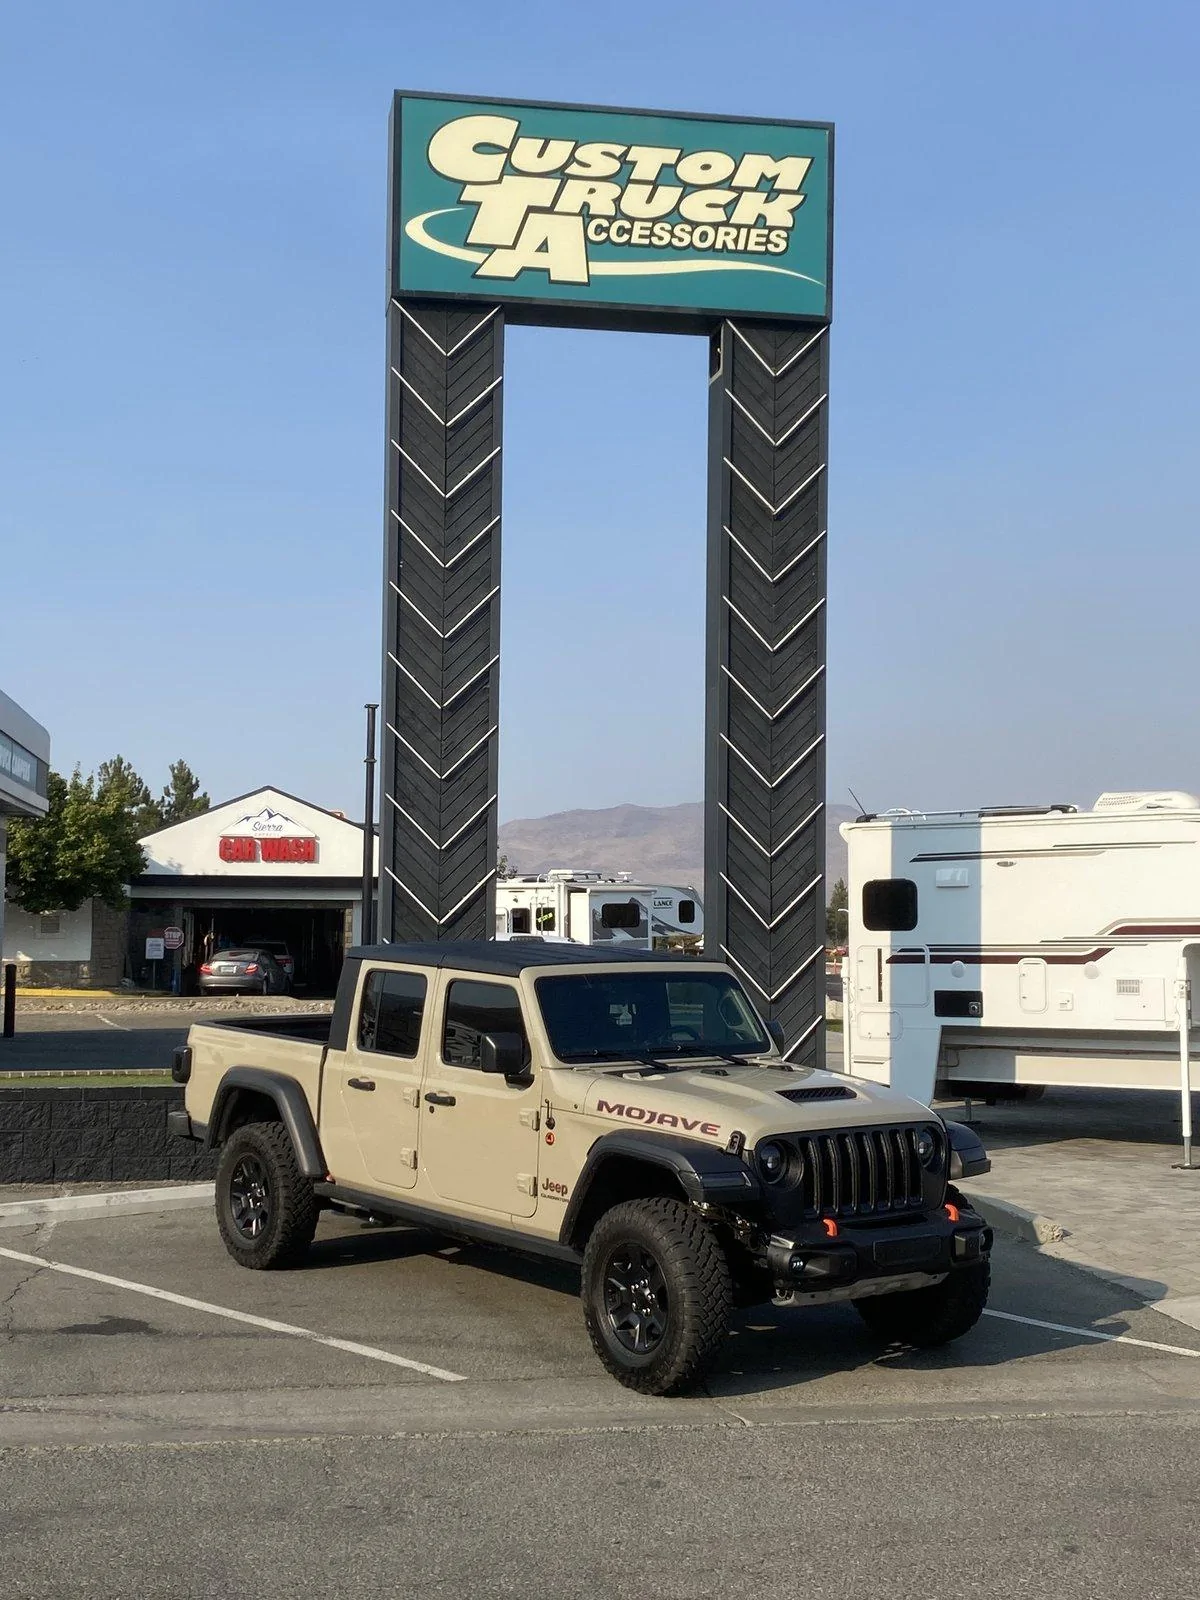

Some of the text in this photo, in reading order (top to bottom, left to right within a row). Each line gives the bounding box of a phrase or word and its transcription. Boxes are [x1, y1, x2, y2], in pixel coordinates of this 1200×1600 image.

[427, 114, 814, 192] CUSTOM
[458, 174, 806, 248] TRUCK
[473, 212, 789, 286] ACCESSORIES
[252, 821, 283, 831] Sierra
[219, 838, 317, 864] CAR WASH
[164, 931, 181, 939] STOP
[596, 1100, 721, 1137] MOJAVE
[541, 1177, 568, 1197] Jeep
